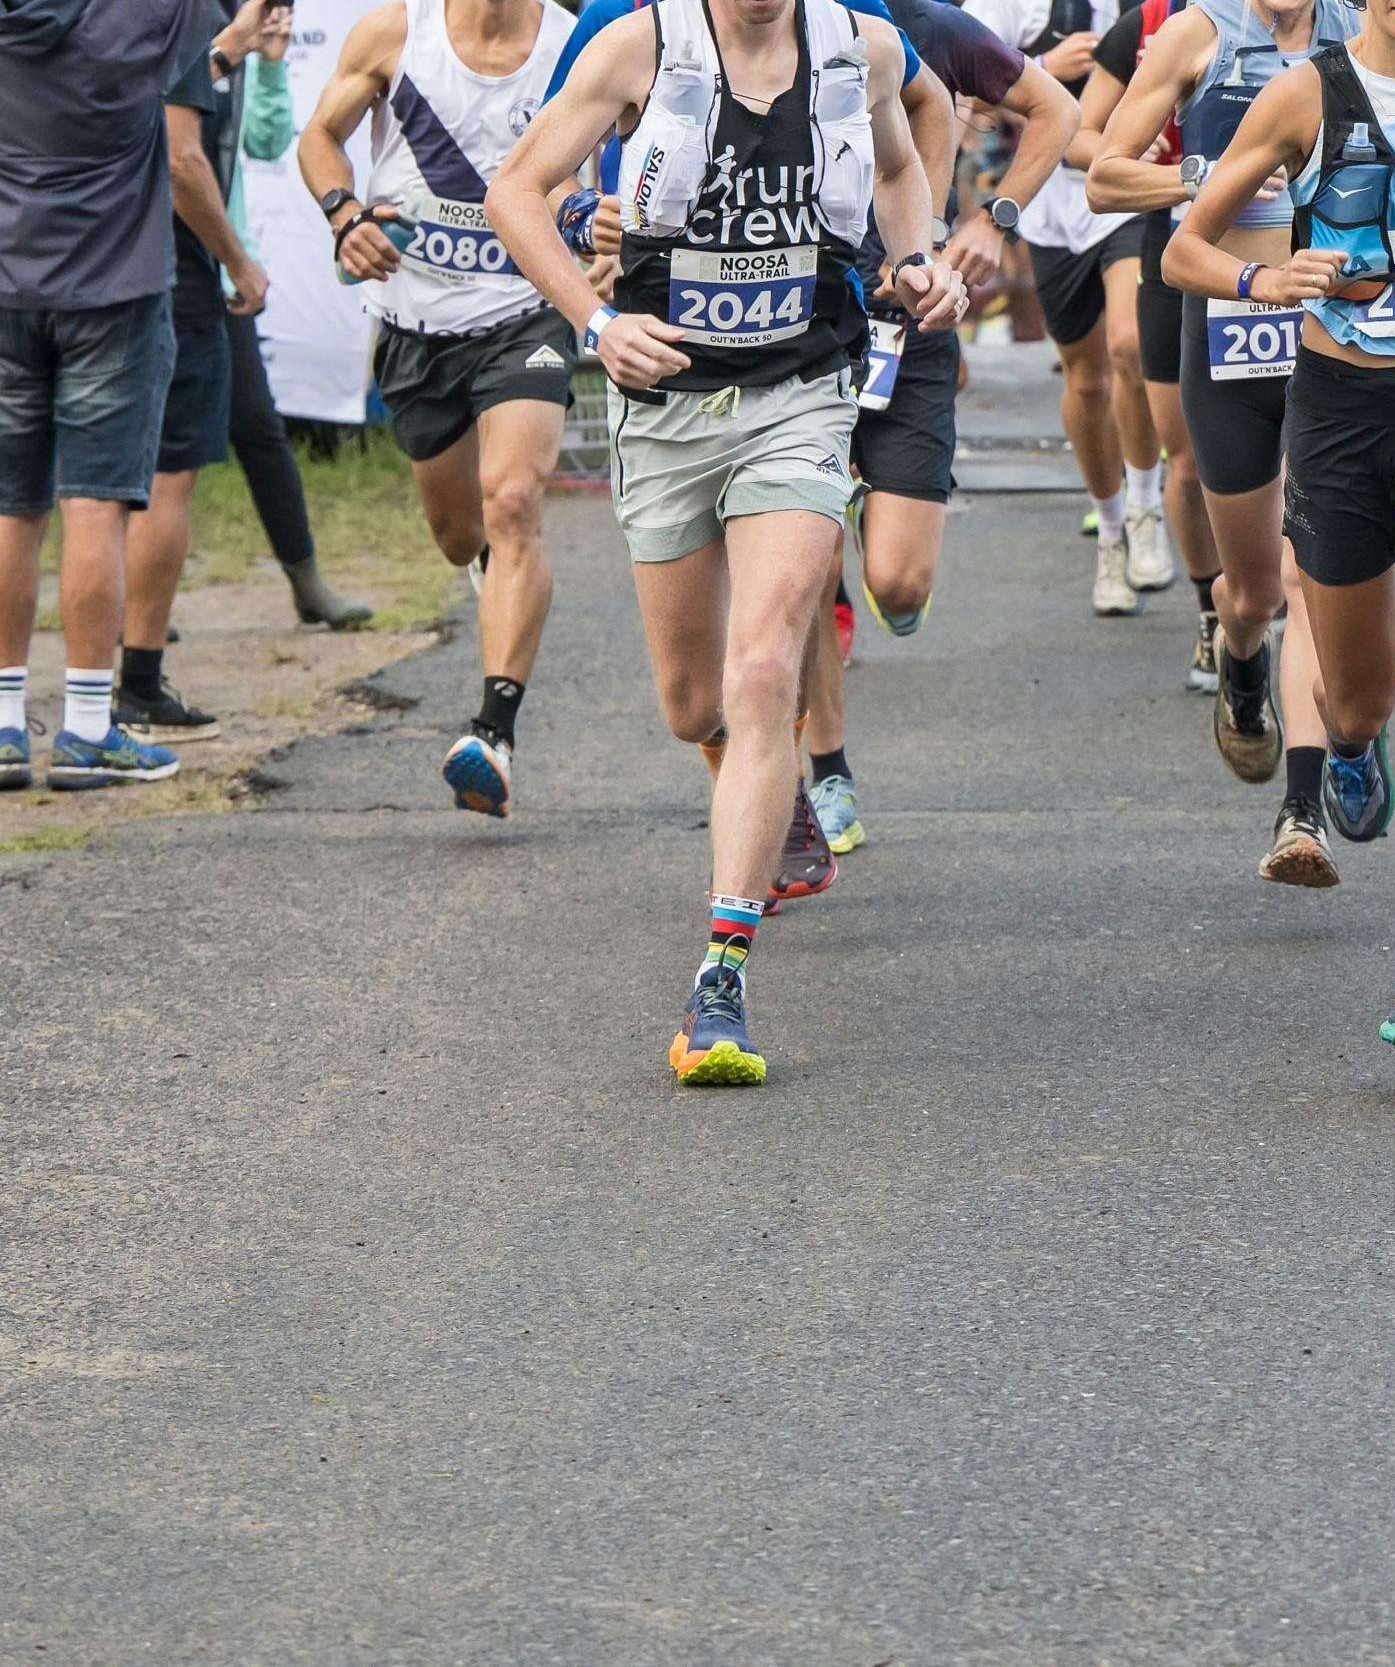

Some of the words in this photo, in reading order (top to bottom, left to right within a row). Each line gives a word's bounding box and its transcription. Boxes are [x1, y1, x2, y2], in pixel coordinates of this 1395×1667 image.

[1221, 94, 1253, 103] SALOM
[439, 202, 487, 220] NOOS
[686, 206, 821, 245] crew
[405, 225, 508, 272] 2080
[720, 253, 789, 271] NOOSA
[720, 268, 790, 281] ULTRA-TRAIL
[678, 285, 803, 330] 2044
[710, 335, 760, 344] OUT'N'BACK
[762, 333, 772, 342] 50
[1222, 321, 1304, 362] 201
